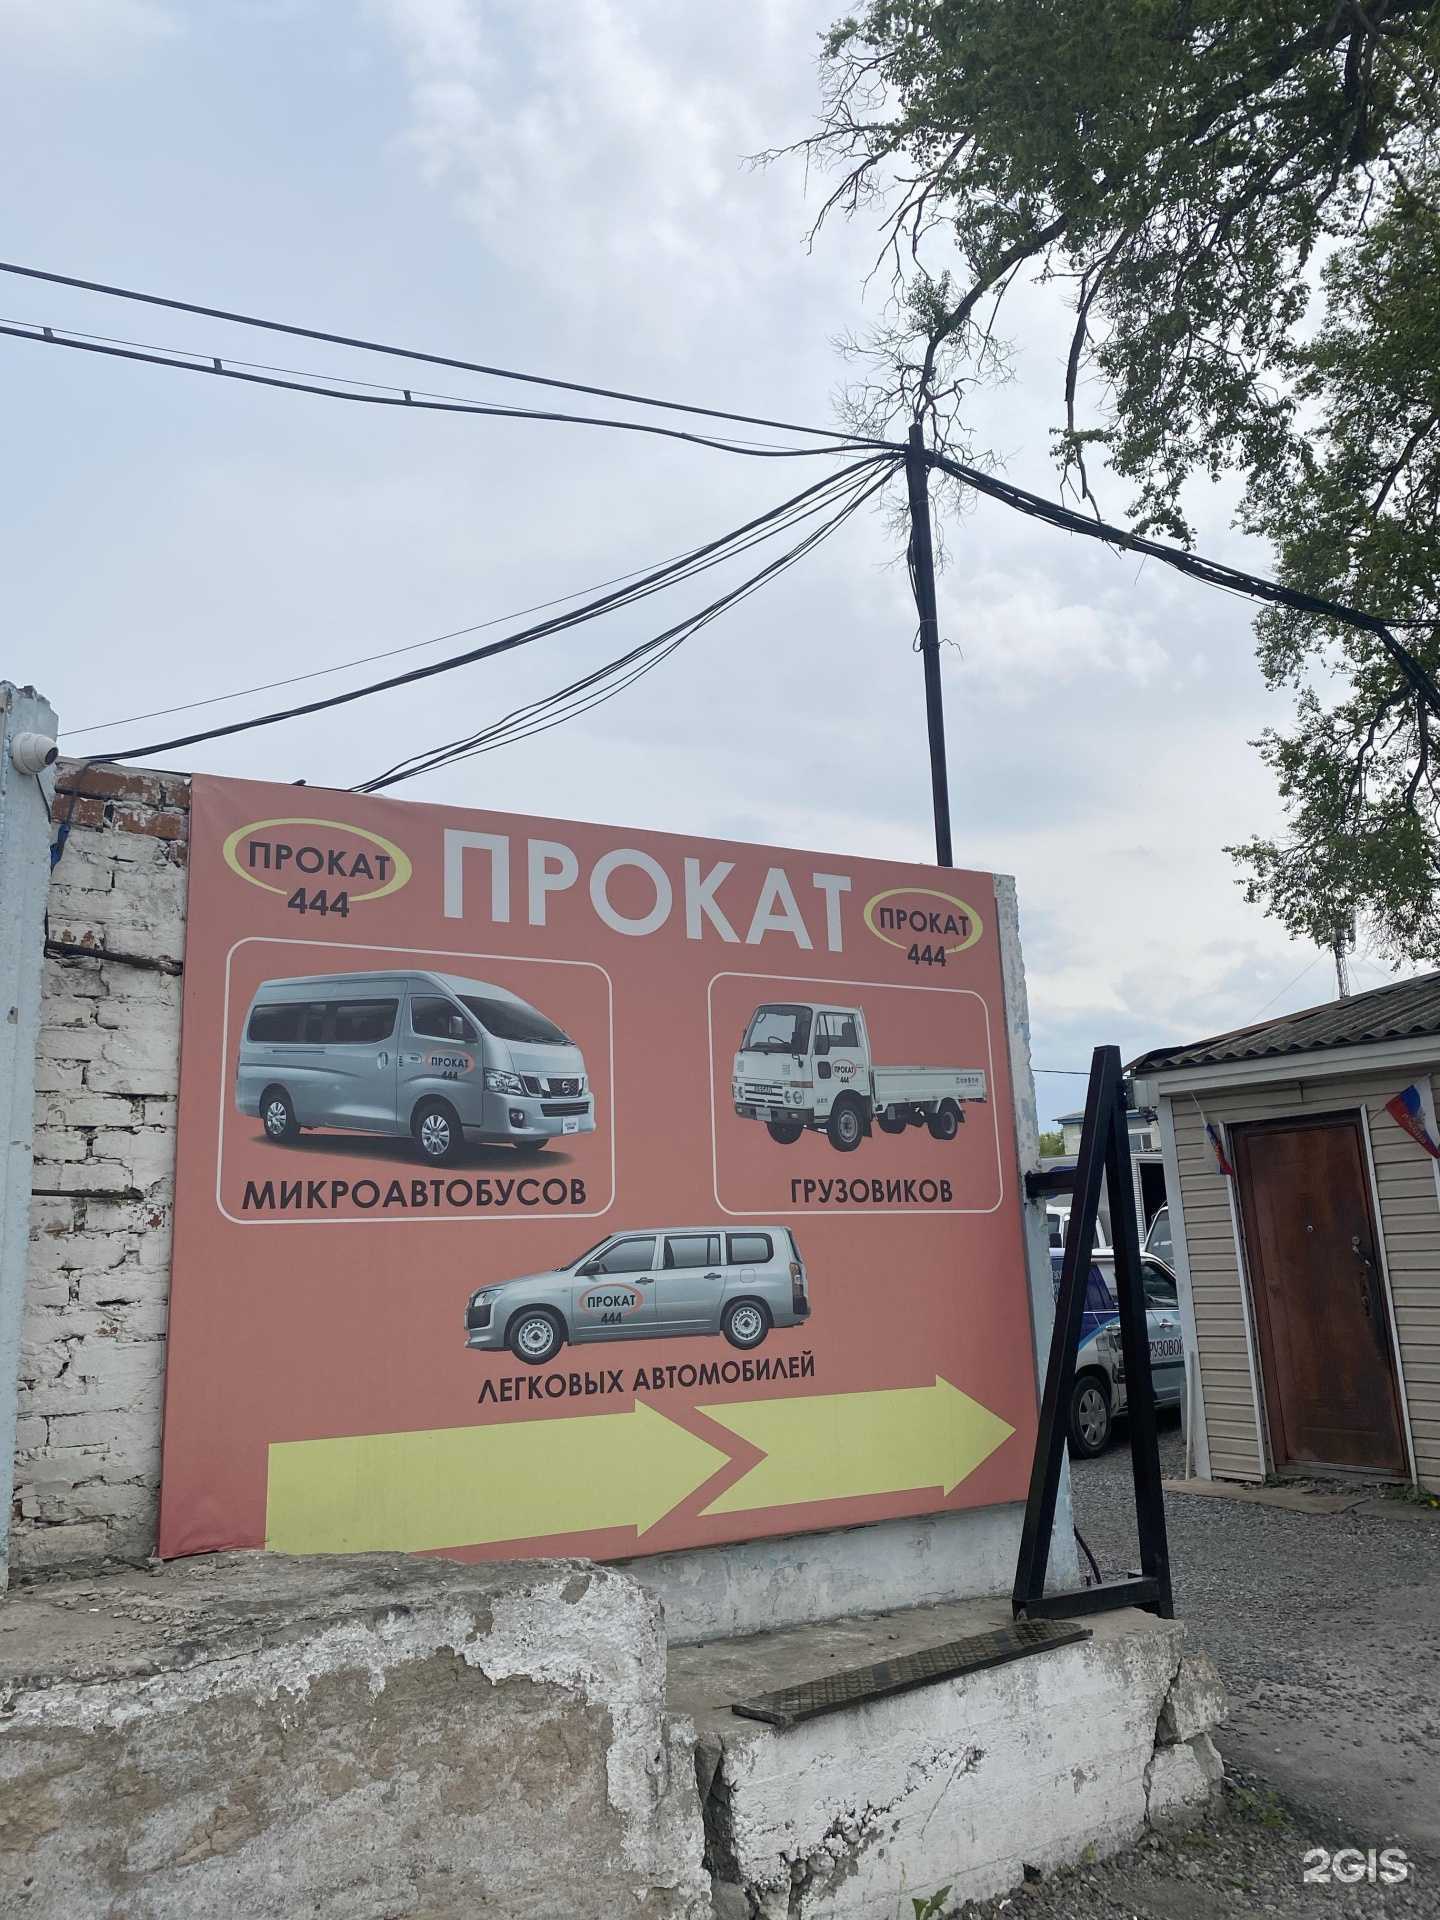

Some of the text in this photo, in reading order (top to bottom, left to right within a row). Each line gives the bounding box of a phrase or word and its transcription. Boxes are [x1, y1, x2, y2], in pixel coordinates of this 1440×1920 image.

[249, 841, 391, 882] ПРОКАТ
[287, 888, 350, 918] 444
[444, 829, 852, 953] ПРОКАТ
[879, 907, 970, 937] ПРОКАТ
[907, 943, 947, 967] 444
[431, 1056, 469, 1069] ПРОКАТ
[441, 1070, 459, 1080] 444
[834, 1065, 854, 1074] ПРОКАТ
[241, 1178, 587, 1210] МИКРОАВТОБУСОВ
[790, 1177, 953, 1204] ГРУЗОВИКОВ
[586, 1294, 636, 1309] ПРОКАТ
[601, 1311, 623, 1324] 444
[1148, 1336, 1184, 1358] РУЗОВОЙ
[477, 1350, 816, 1404] ЛЕГКОВЫХ АВТОМОБИЛЕЙ
